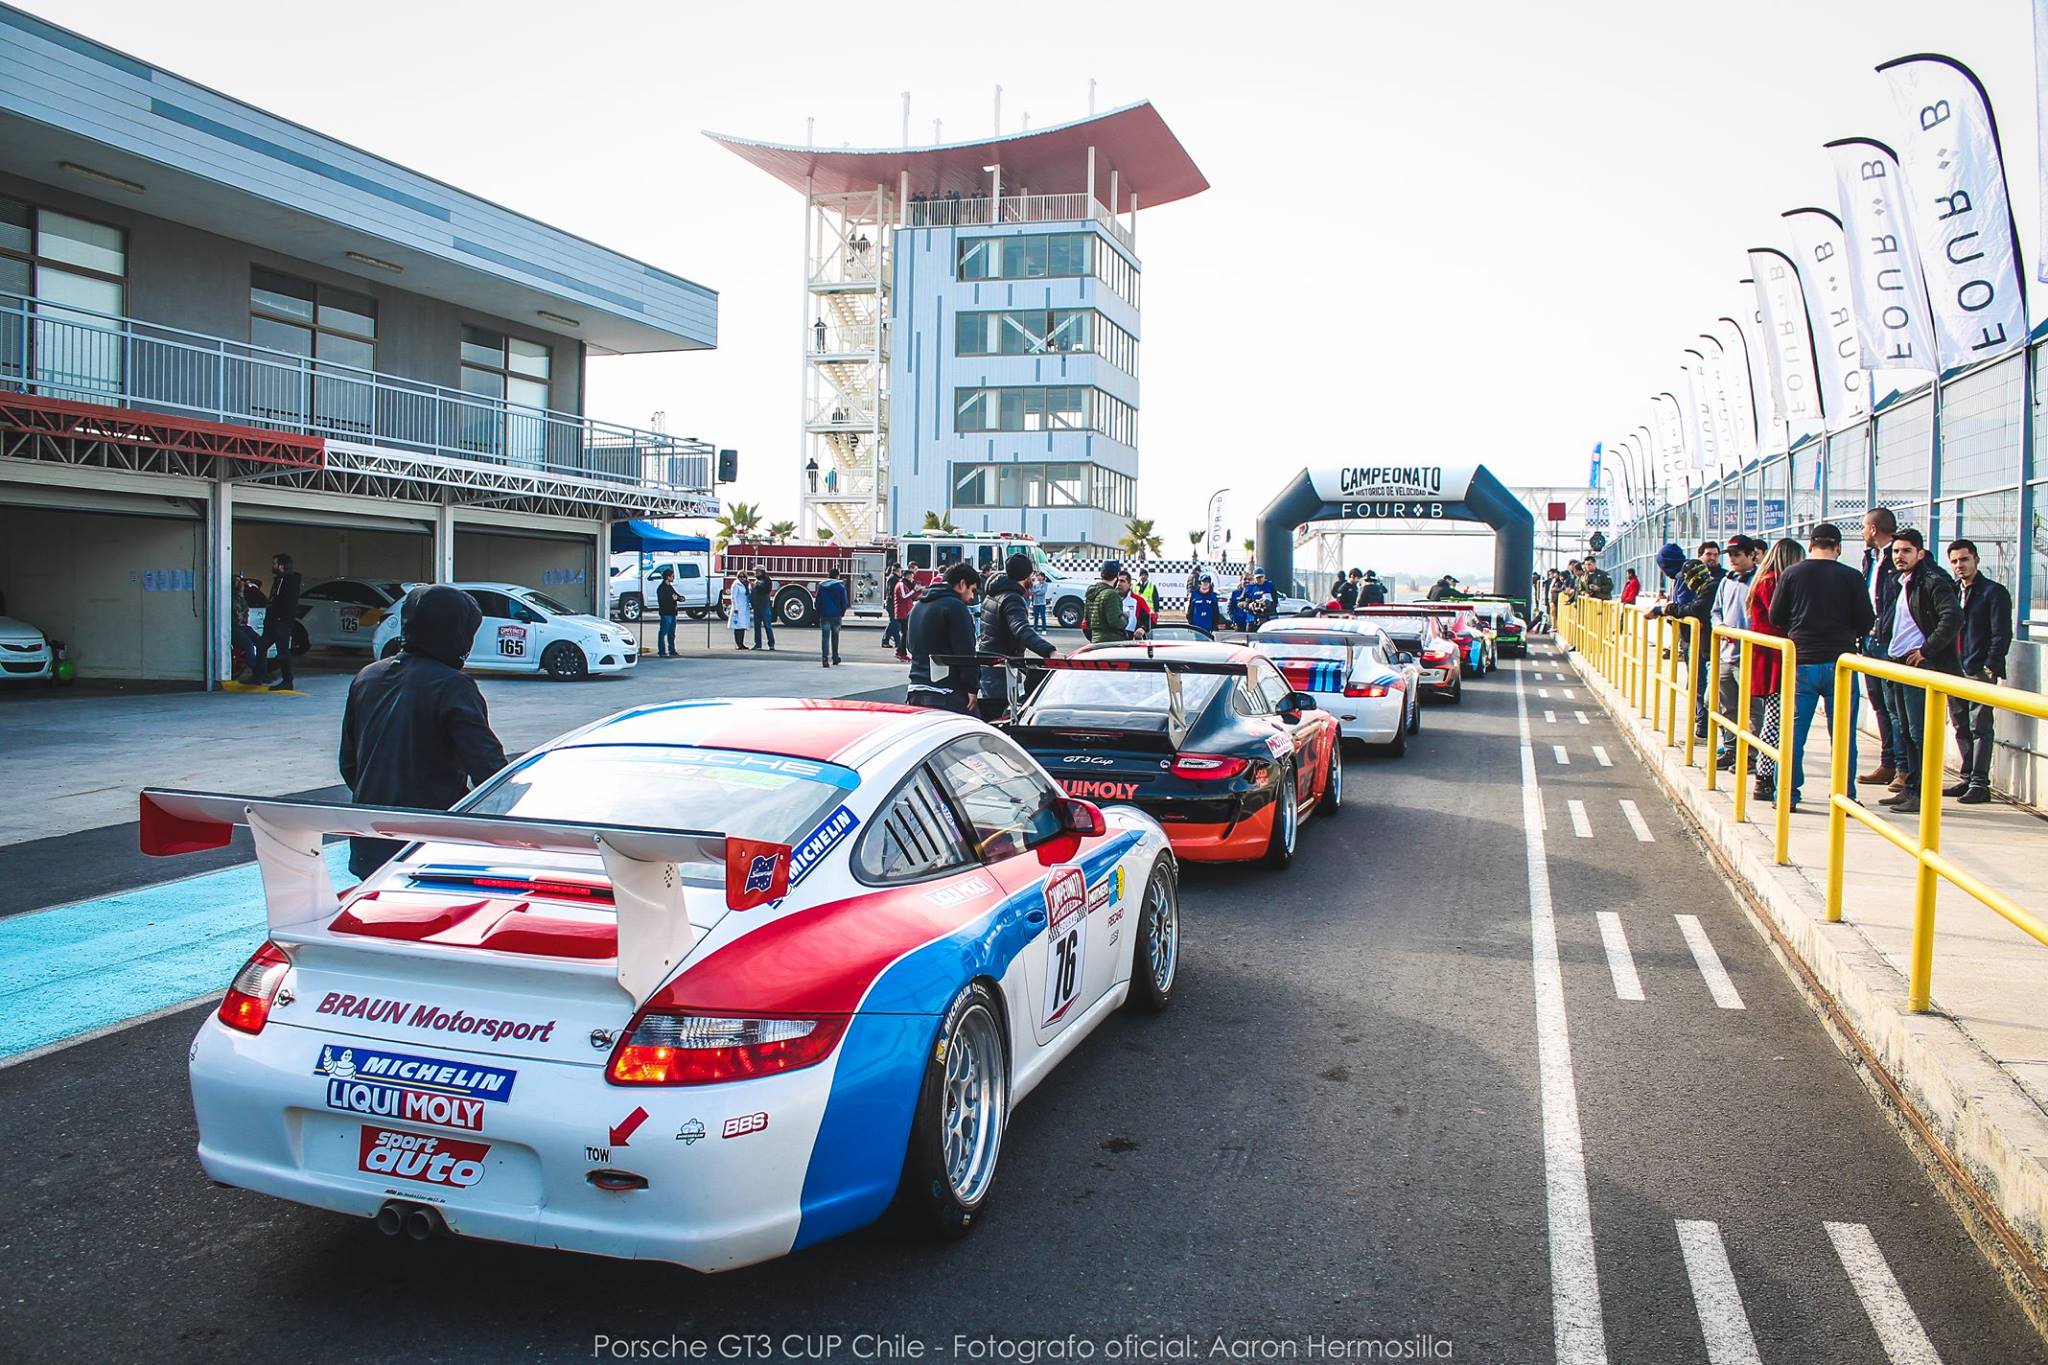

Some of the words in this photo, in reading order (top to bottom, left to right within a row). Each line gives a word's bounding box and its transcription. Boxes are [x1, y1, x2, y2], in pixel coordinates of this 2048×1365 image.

[1341, 467, 1441, 492] CAMPEONATO
[1341, 503, 1406, 518] FOUR
[1431, 503, 1443, 518] B
[342, 617, 358, 631] 125
[498, 639, 524, 655] 165
[789, 808, 852, 882] MICHELIN
[1053, 929, 1078, 1011] 76
[316, 991, 410, 1025] BRAUN
[407, 1005, 557, 1042] Motorsport
[945, 984, 972, 1034] MICHELIN
[361, 1056, 507, 1092] MICHELIN
[329, 1080, 400, 1117] LIQUI
[405, 1092, 484, 1129] MOLY
[724, 1113, 766, 1137] BBS
[375, 1131, 438, 1154] sport
[586, 1146, 610, 1162] TOW
[365, 1146, 486, 1187] auto
